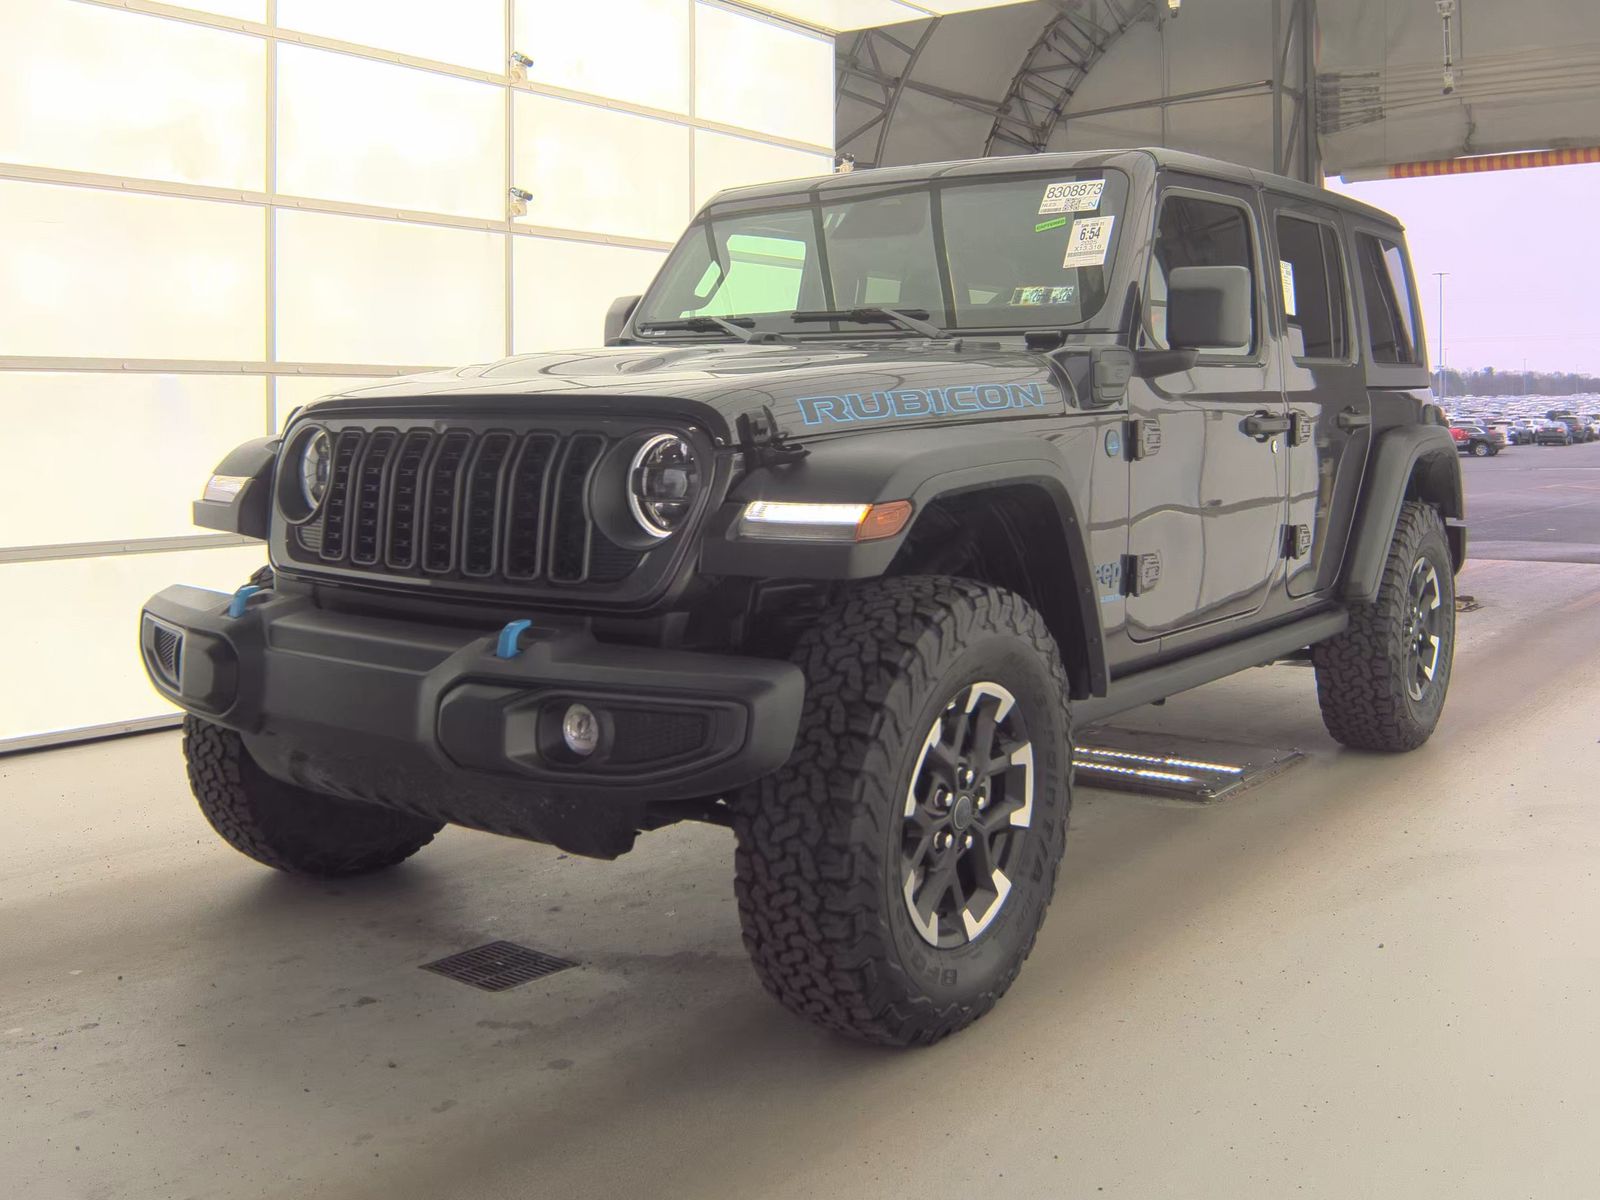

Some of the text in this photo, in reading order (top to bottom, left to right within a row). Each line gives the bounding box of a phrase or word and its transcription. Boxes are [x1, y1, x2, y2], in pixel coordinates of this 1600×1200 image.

[1047, 183, 1103, 198] 8308873
[1080, 226, 1101, 240] 6:54
[796, 383, 1043, 425] RUBICON
